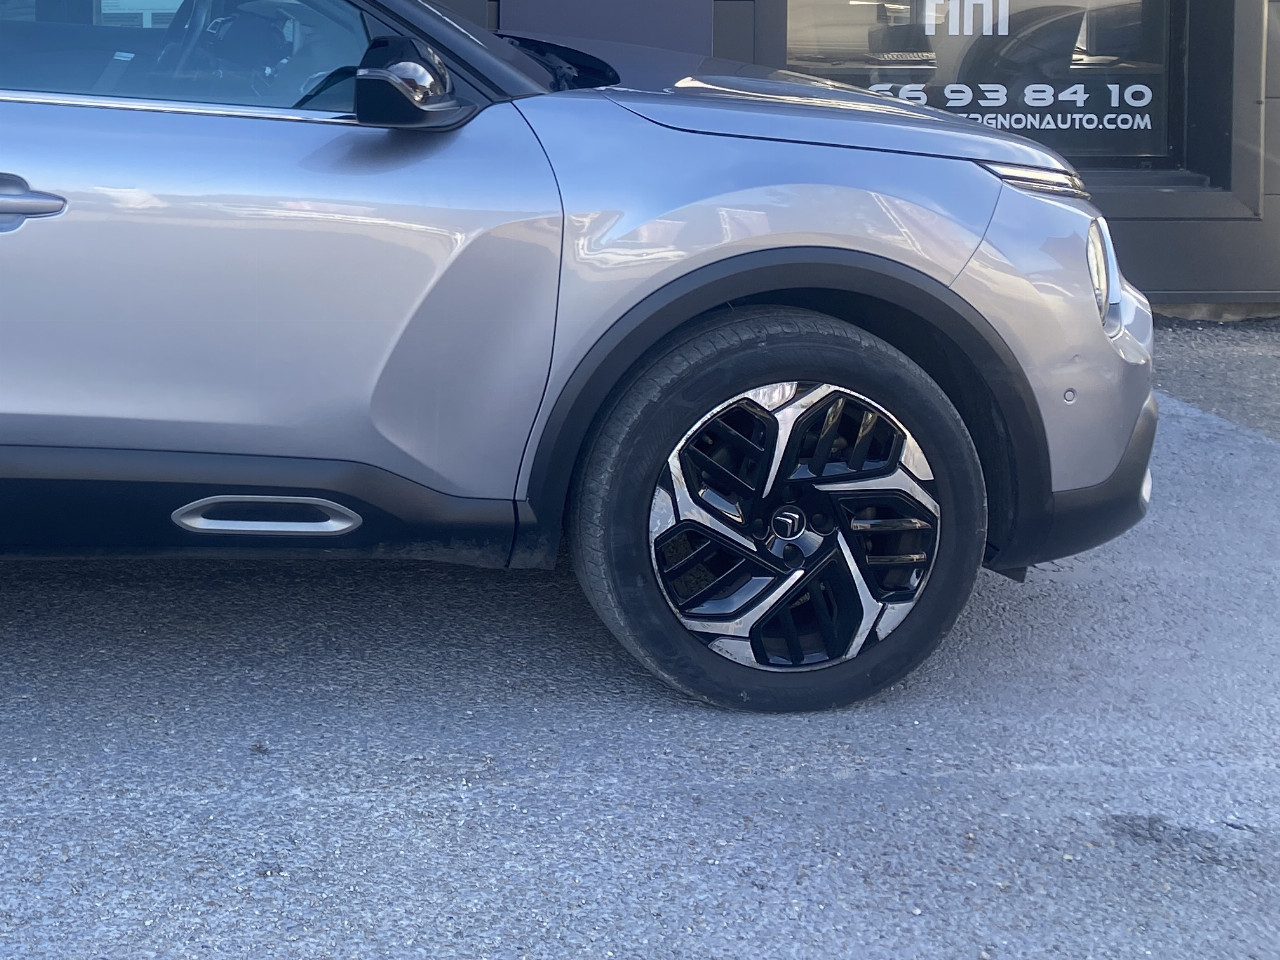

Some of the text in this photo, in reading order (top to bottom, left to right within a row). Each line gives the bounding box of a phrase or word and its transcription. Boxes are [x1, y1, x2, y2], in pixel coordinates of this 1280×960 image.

[944, 83, 1008, 107] 93
[1023, 83, 1090, 107] 84
[1107, 83, 1153, 107] 10
